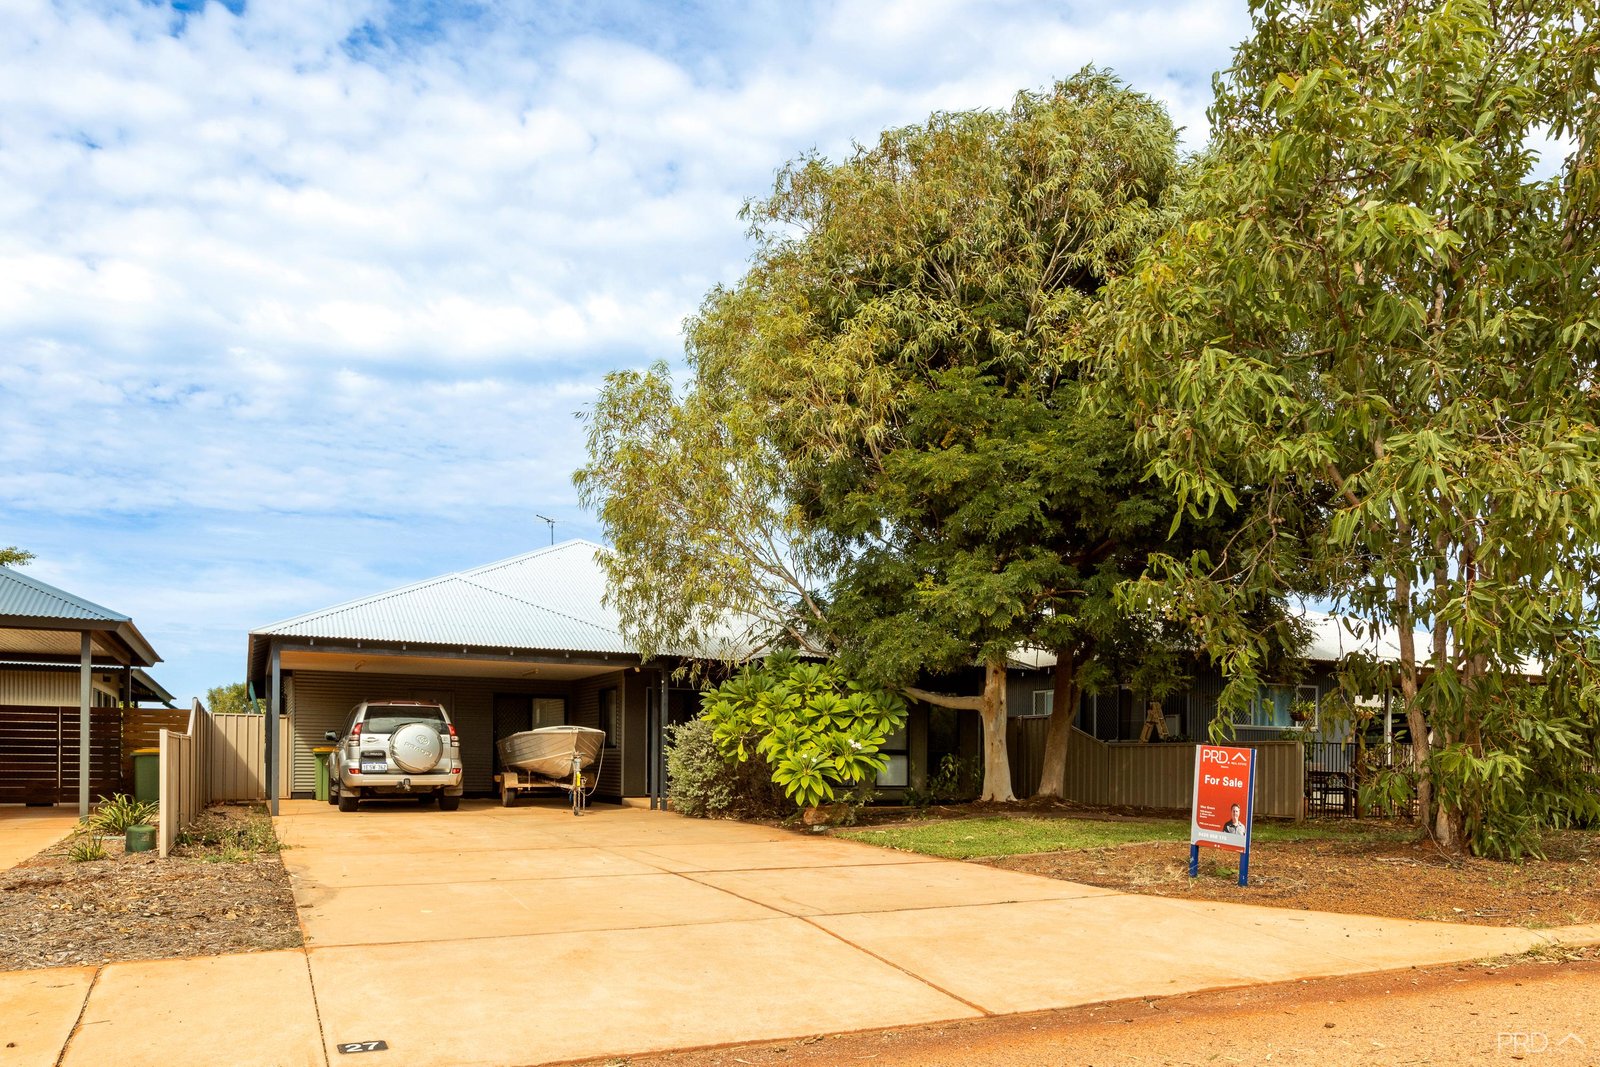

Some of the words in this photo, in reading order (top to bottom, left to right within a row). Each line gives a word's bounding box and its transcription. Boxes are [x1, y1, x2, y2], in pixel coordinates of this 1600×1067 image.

[1204, 774, 1220, 785] For
[1222, 776, 1243, 788] Sale
[344, 1041, 379, 1053] 27
